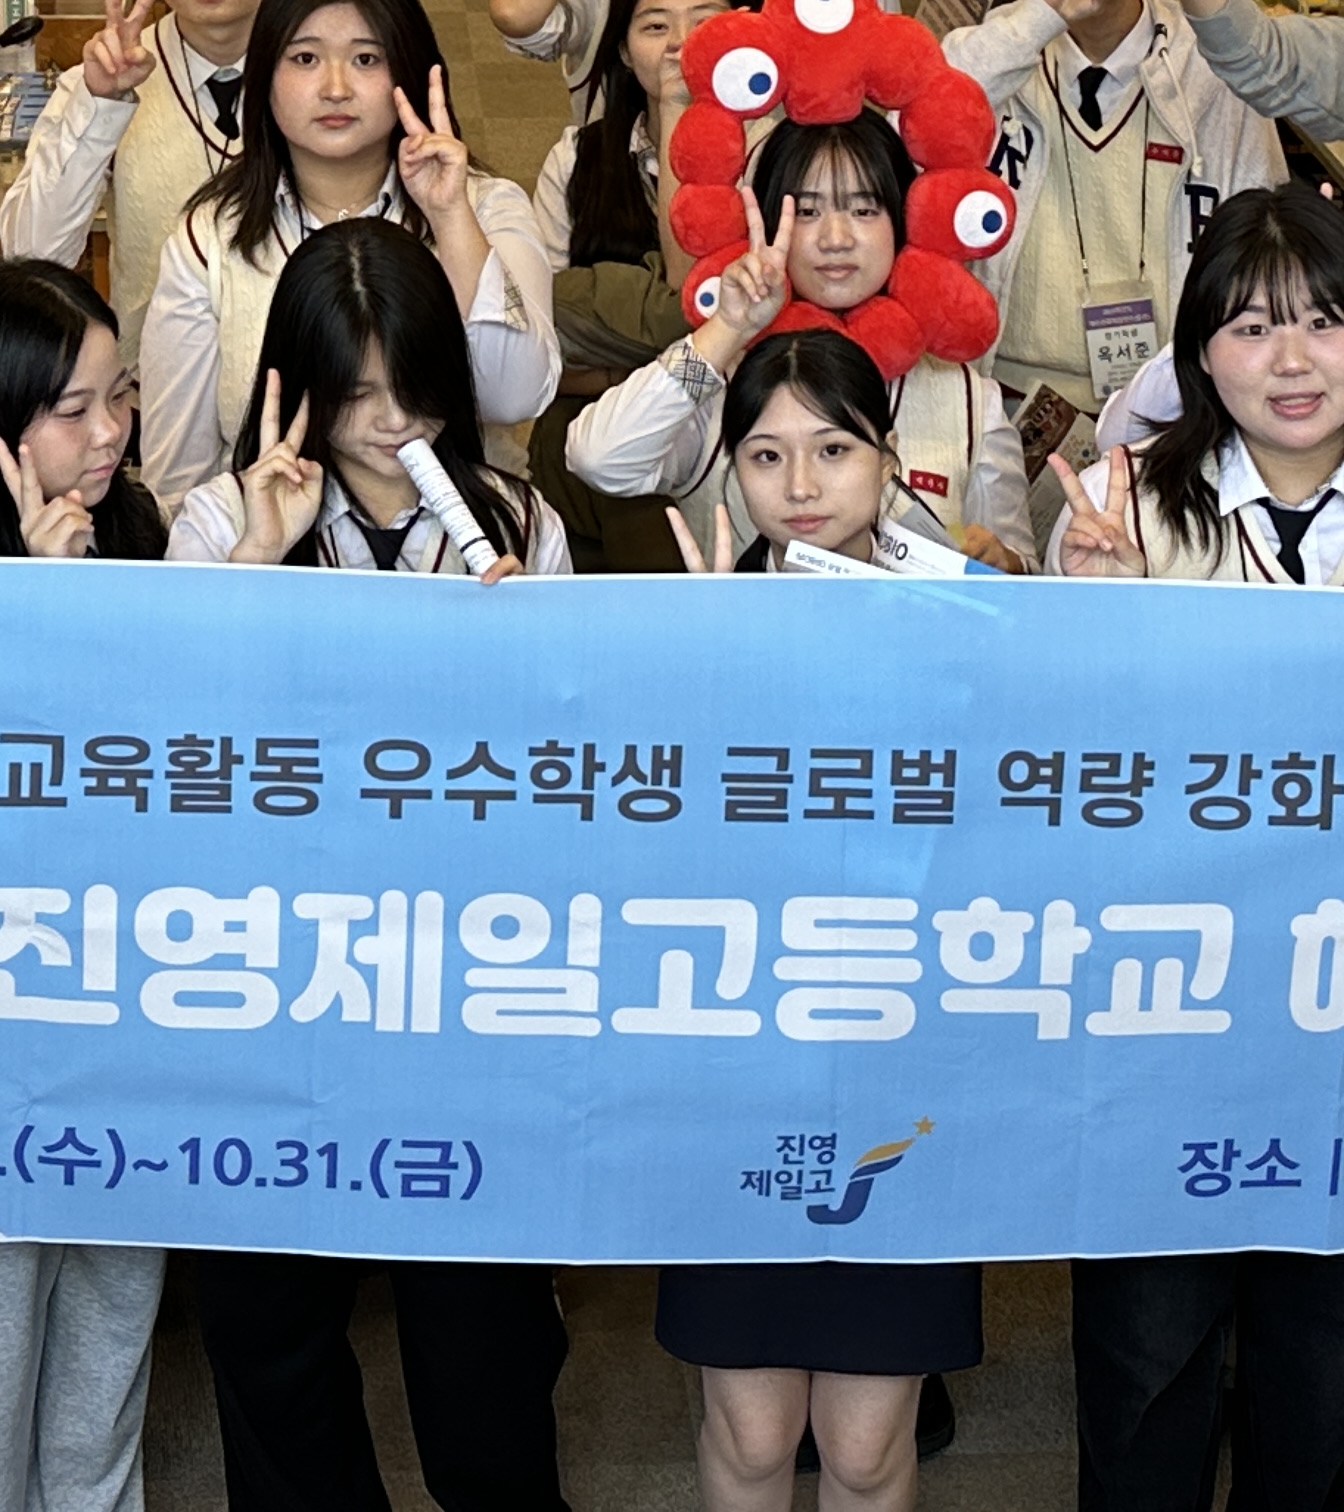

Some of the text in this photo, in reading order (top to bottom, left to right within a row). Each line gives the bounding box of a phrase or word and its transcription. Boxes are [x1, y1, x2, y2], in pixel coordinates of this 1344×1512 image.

[360, 740, 683, 823] 우수학생
[721, 747, 957, 825] 글로벌
[998, 750, 1155, 828] 역량
[775, 1132, 838, 1166] 진영
[1178, 1137, 1303, 1198] 장소
[739, 1168, 836, 1201] 제일고
